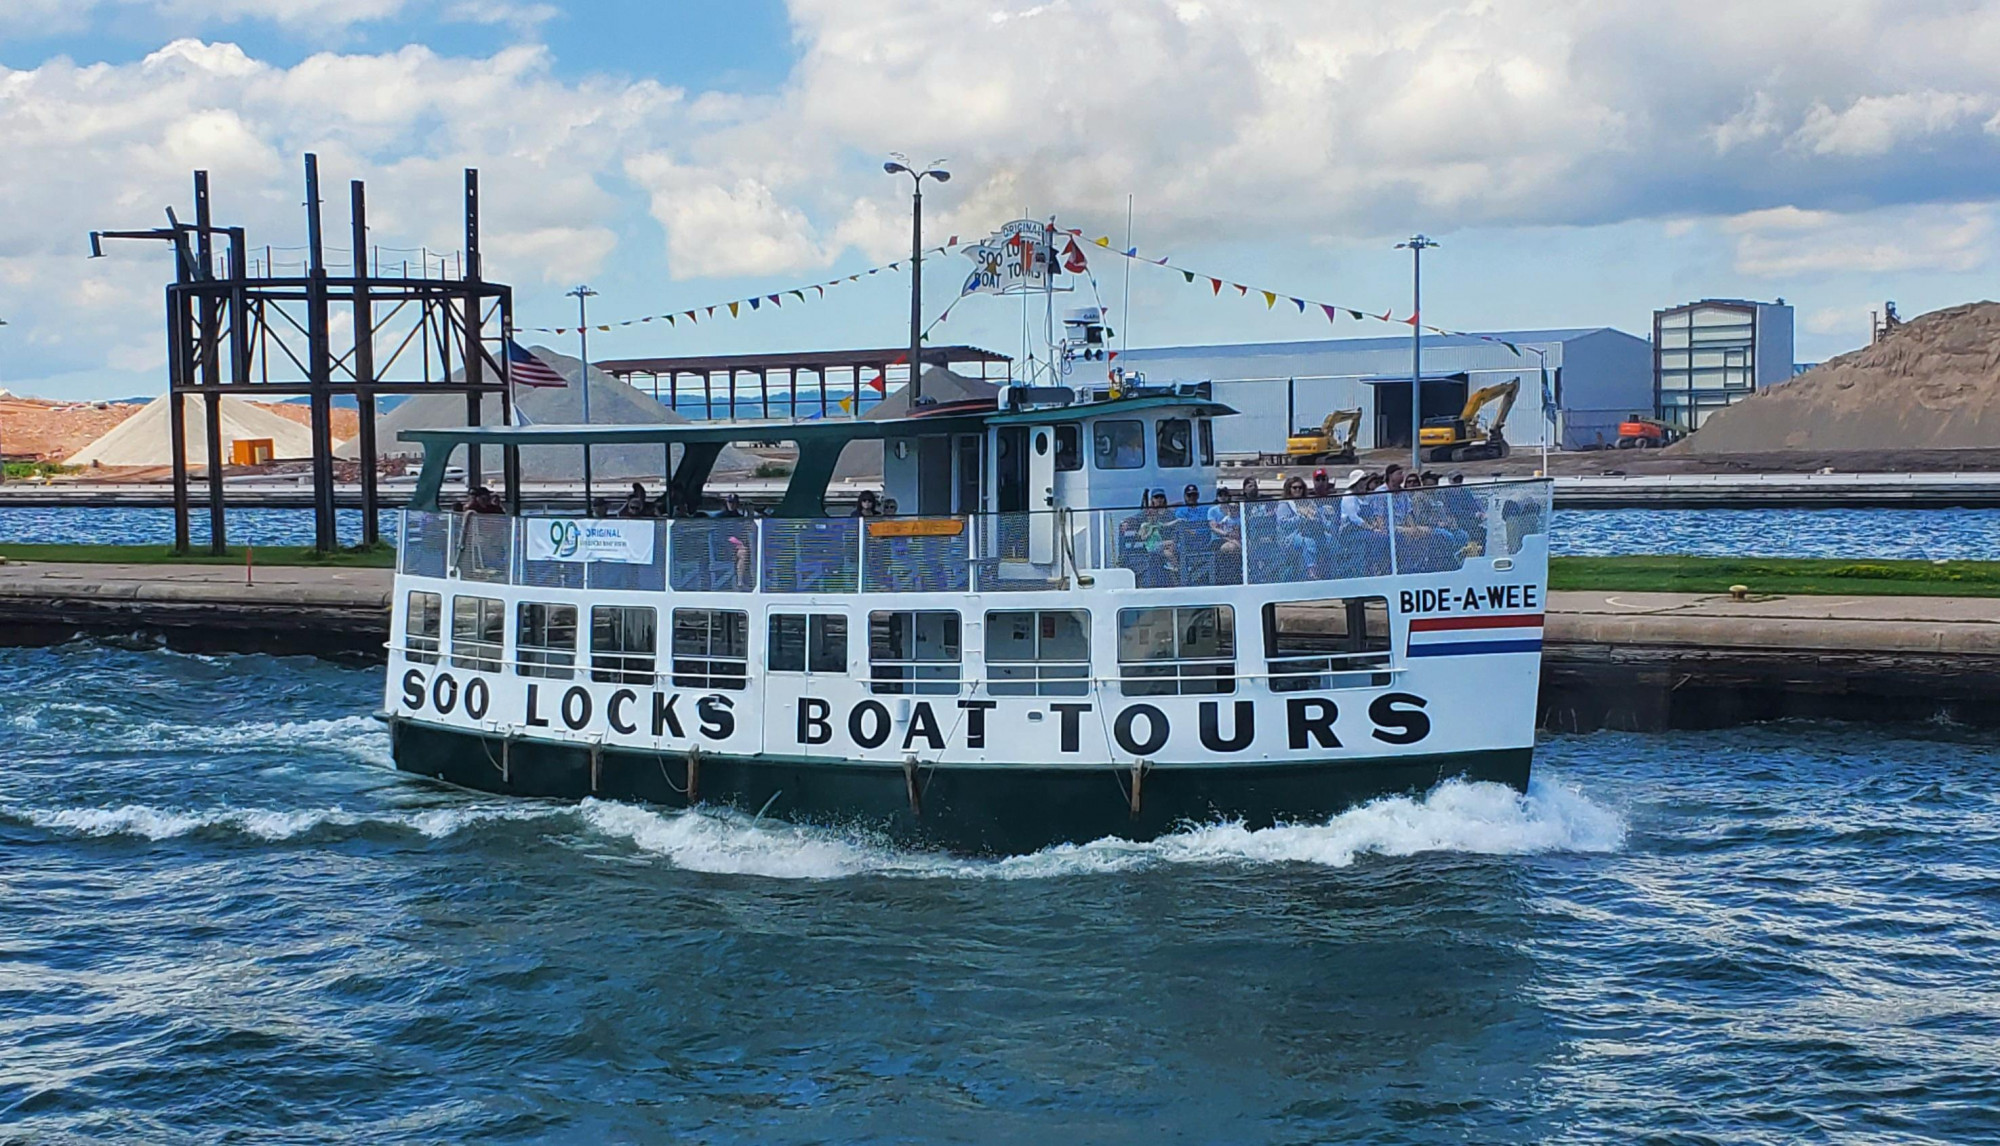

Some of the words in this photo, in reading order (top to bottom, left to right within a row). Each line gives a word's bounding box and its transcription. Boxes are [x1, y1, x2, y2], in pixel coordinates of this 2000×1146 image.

[1003, 223, 1041, 237] ORIGINAL
[978, 250, 1003, 267] SOO
[586, 528, 622, 538] ORIGINAL
[1400, 585, 1537, 614] BIDE-A-WEE
[402, 668, 489, 720] SOO
[527, 684, 735, 740] LOCKS
[797, 697, 997, 750] BOAT
[1050, 692, 1431, 756] TOURS
